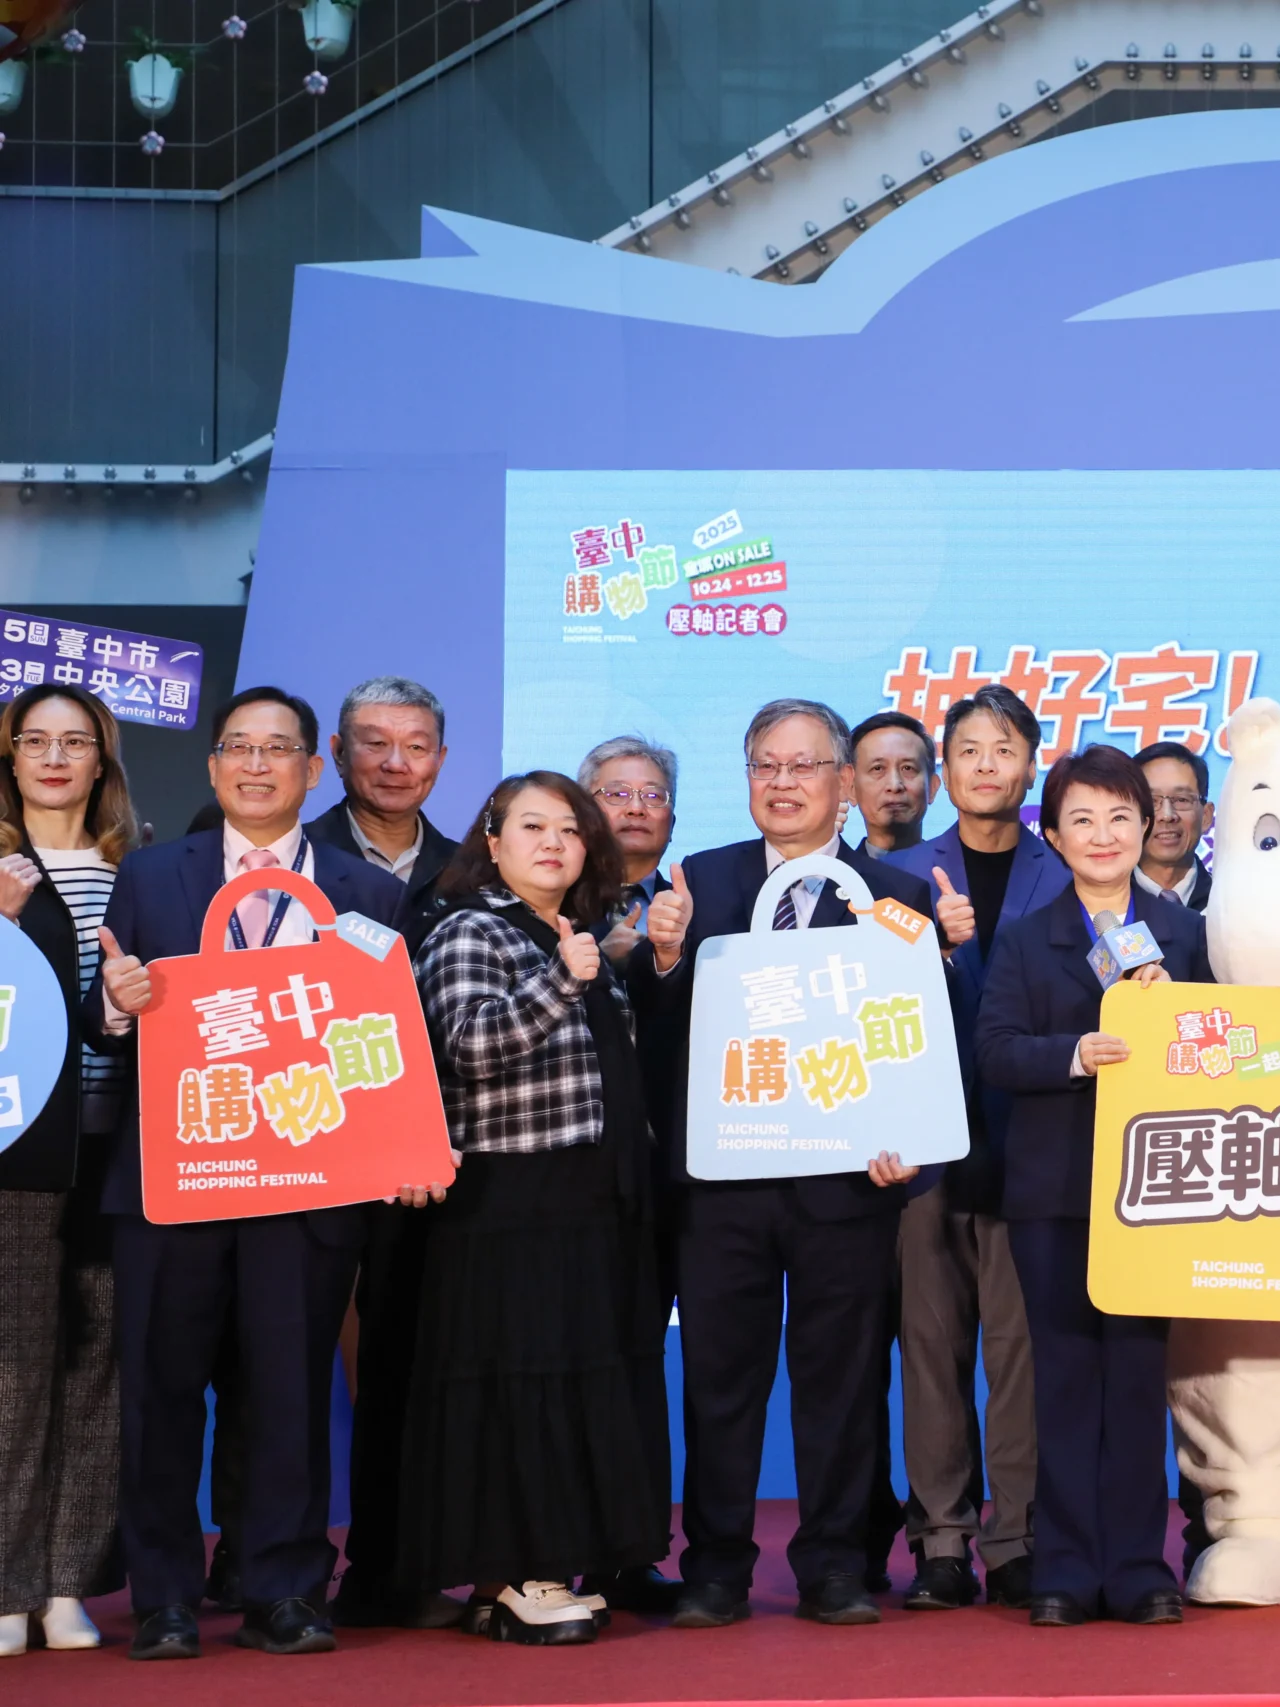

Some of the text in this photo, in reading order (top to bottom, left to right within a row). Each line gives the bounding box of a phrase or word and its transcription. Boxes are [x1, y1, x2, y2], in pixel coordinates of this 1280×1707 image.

[571, 519, 645, 570] 臺中
[697, 516, 738, 545] 2025
[737, 541, 771, 564] SALE
[564, 545, 678, 620] 購物節
[668, 607, 783, 633] 壓軸記者會
[4, 619, 26, 642] 5
[56, 628, 160, 671] 臺中市
[30, 635, 46, 644] SUN
[0, 659, 22, 682] 3
[53, 661, 190, 710] 中央公園
[26, 675, 40, 683] TUE
[111, 703, 186, 724] Central Park
[881, 904, 921, 934] SALE
[346, 919, 389, 950] SALE
[740, 953, 866, 1030] 臺中
[192, 973, 333, 1060] 臺中
[1175, 1007, 1233, 1042] 臺中
[720, 994, 928, 1114] 購物節
[1167, 1025, 1258, 1079] 購物節
[176, 1013, 404, 1147] 購物節
[718, 1124, 789, 1135] TAICHUNG
[717, 1138, 851, 1151] SHOPPING FESTIVAL
[177, 1159, 258, 1175] TAICHUNG
[177, 1172, 328, 1191] SHOPPING FESTIVAL
[1193, 1261, 1265, 1275] TAICHUNG
[1192, 1276, 1263, 1291] SHOPPING
